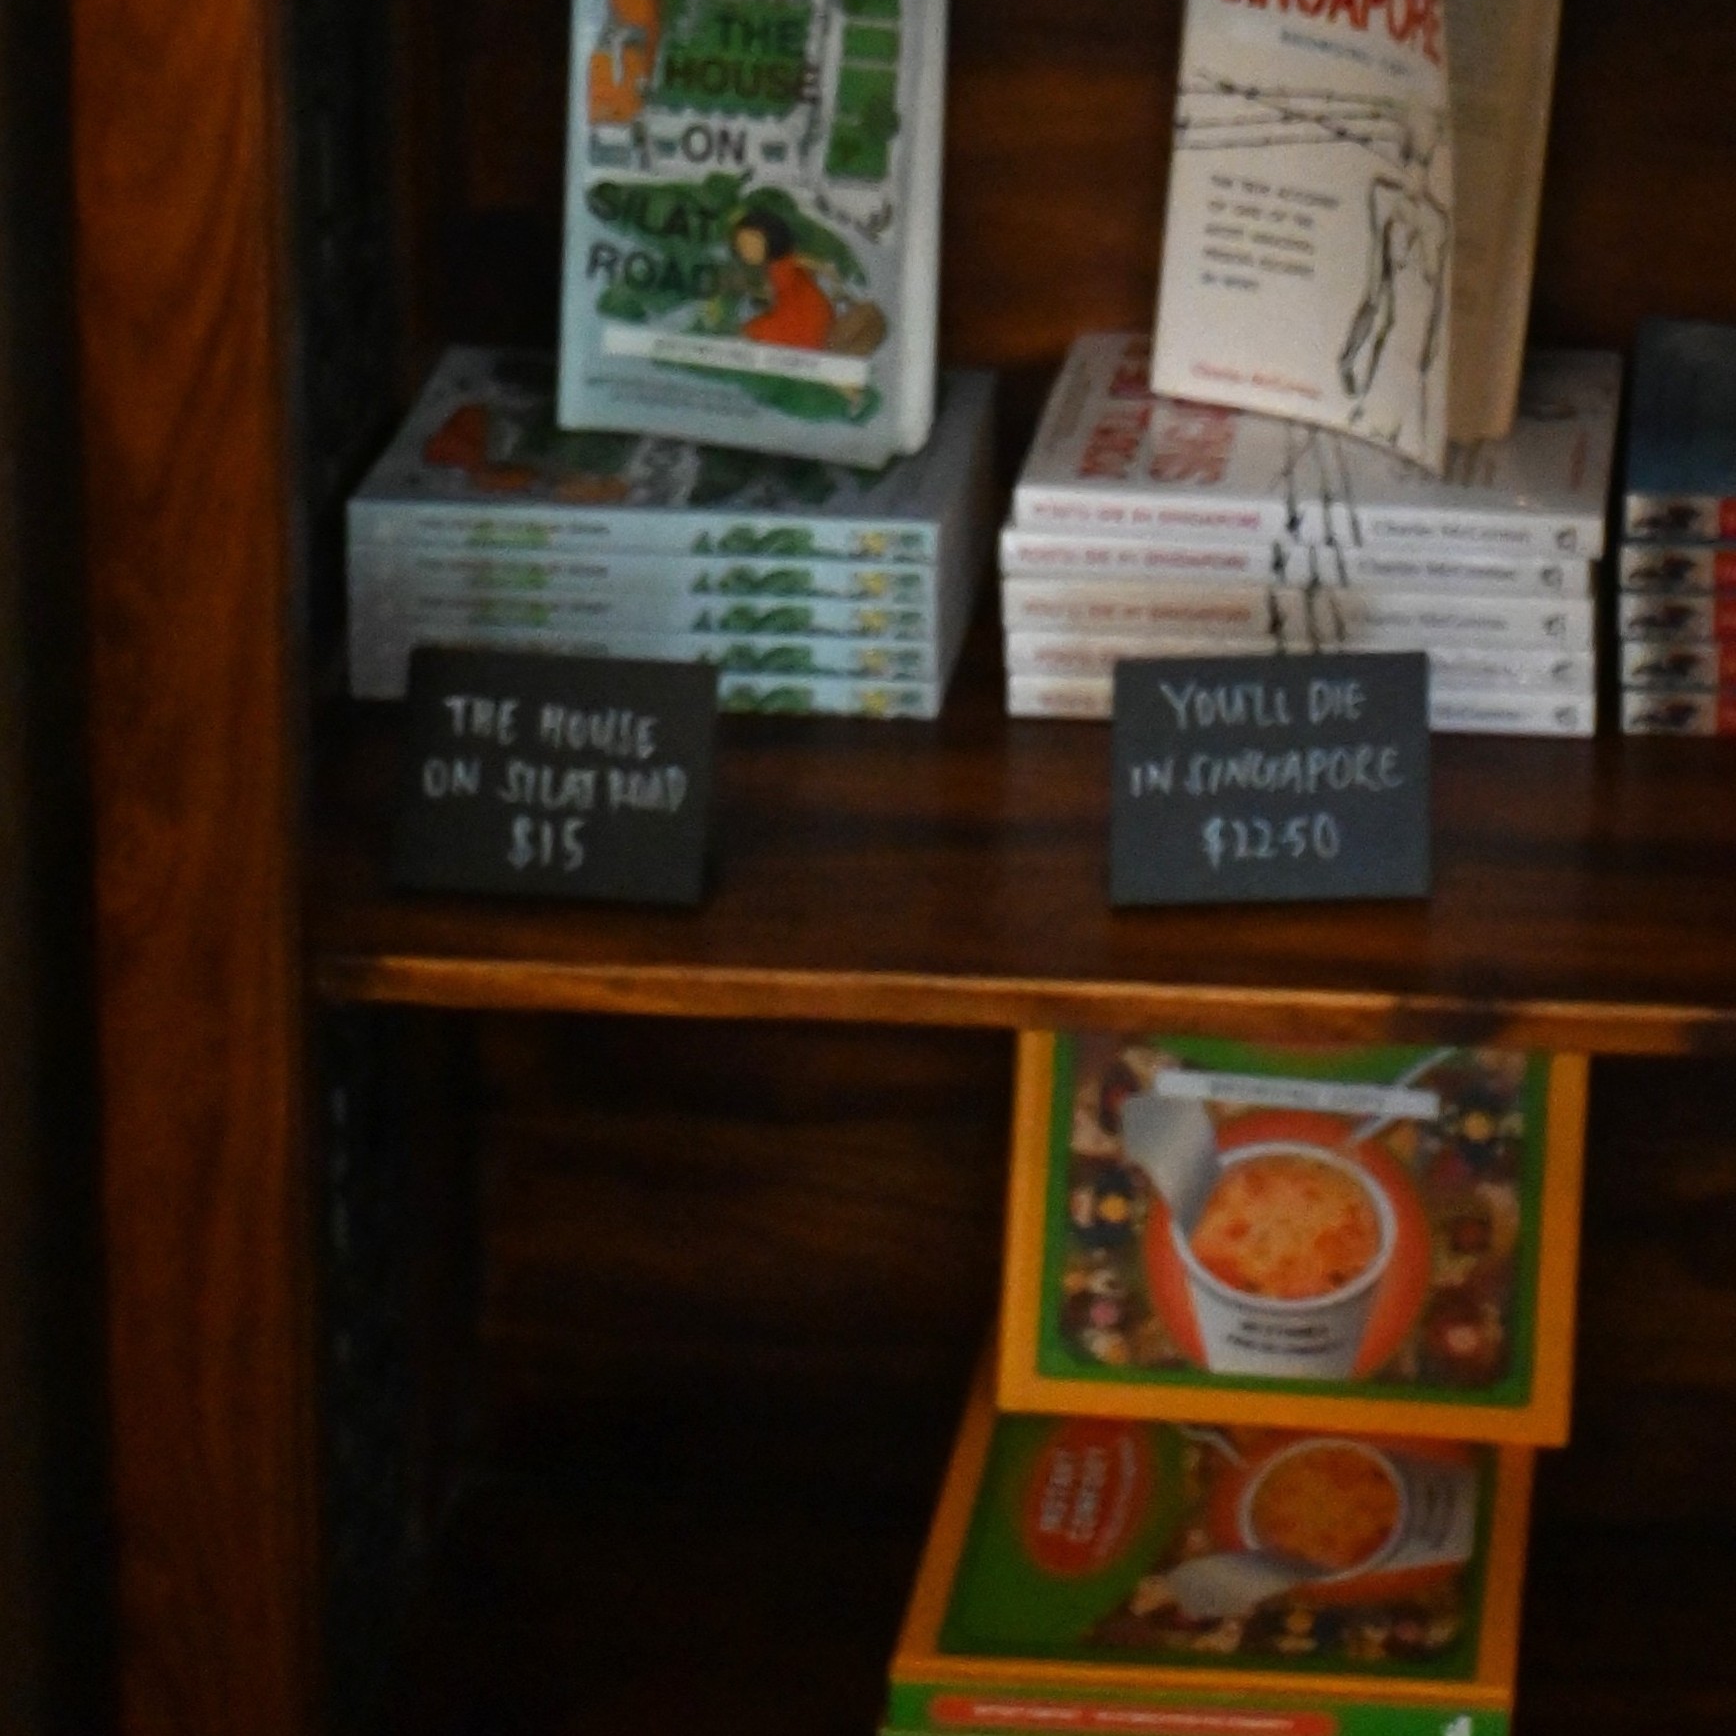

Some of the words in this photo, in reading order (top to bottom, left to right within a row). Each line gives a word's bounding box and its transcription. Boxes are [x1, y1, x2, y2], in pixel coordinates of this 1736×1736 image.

[662, 57, 820, 107] HOUSE
[682, 127, 747, 164] ON
[444, 695, 520, 746] THE
[422, 758, 480, 799] ON
